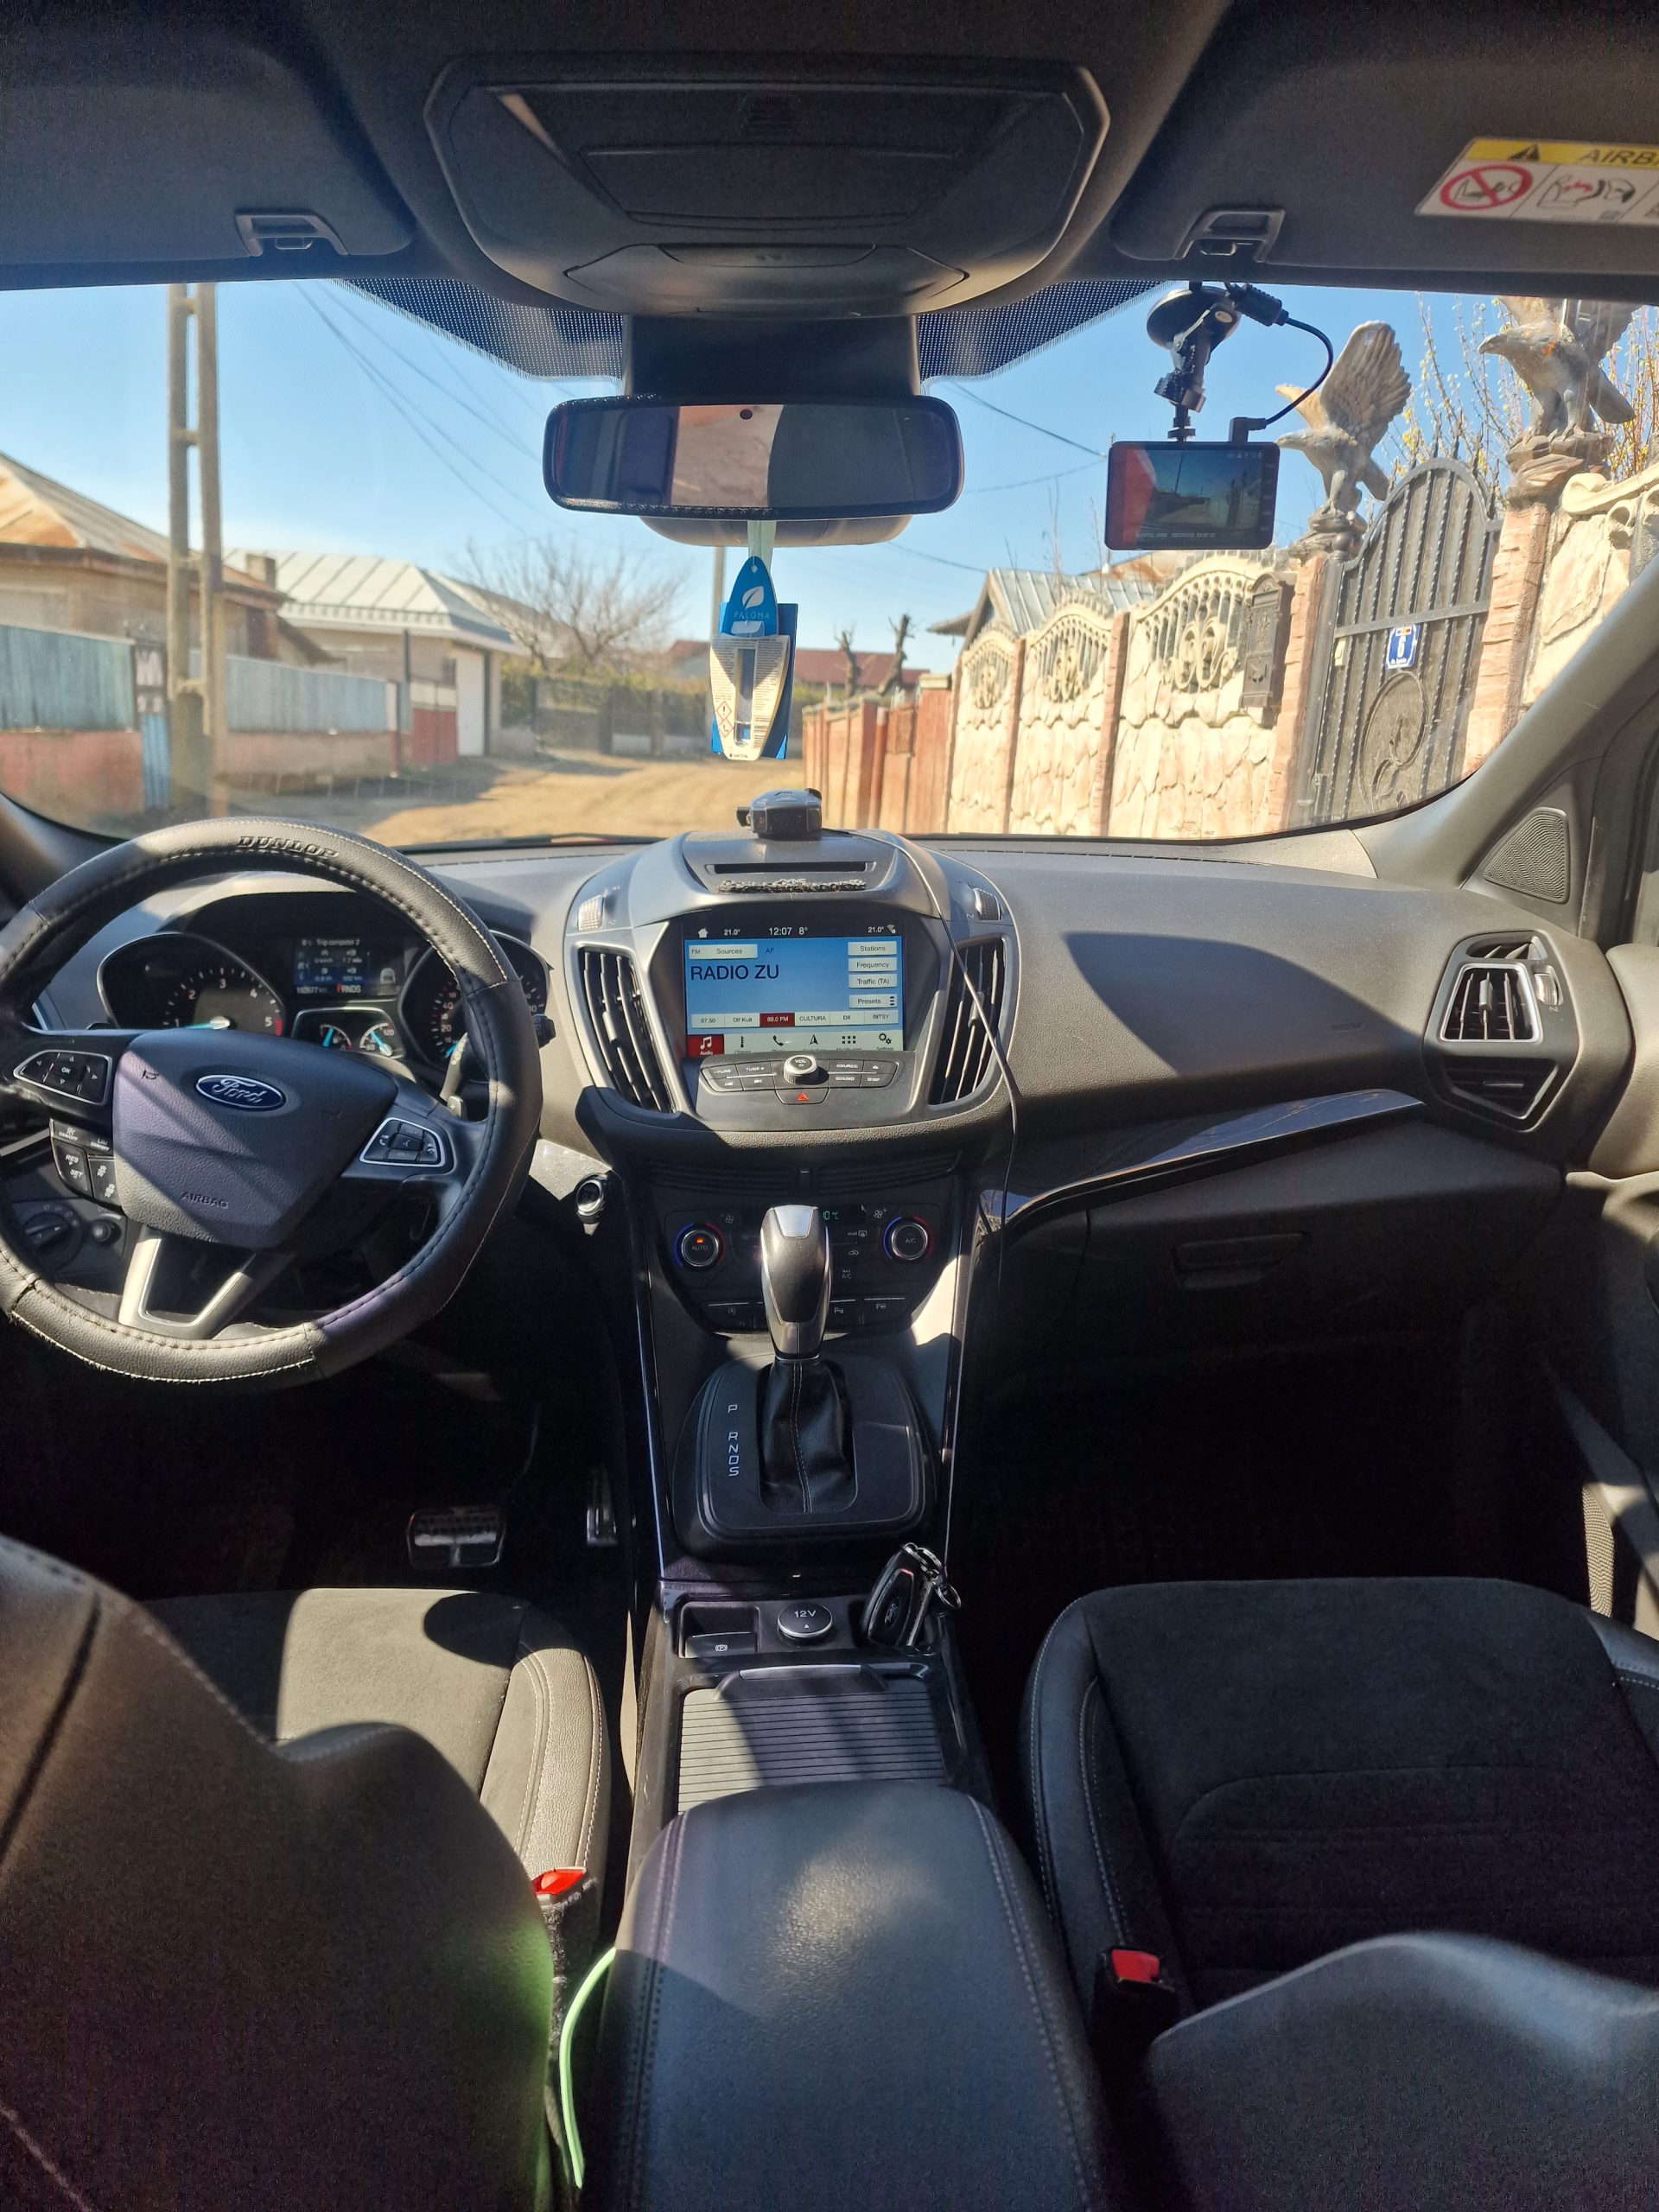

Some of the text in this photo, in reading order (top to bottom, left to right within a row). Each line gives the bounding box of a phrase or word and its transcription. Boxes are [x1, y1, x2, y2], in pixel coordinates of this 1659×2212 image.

[734, 610, 770, 620] PALOMA
[236, 836, 340, 859] DUNLOP
[768, 926, 792, 936] 12:07
[690, 964, 779, 981] RADIO ZU
[264, 1016, 273, 1027] 5
[212, 1077, 268, 1104] Ford
[181, 1192, 230, 1209] AIRBAG
[728, 1404, 738, 1414] P
[728, 1432, 739, 1441] R
[728, 1444, 739, 1453] N
[728, 1455, 739, 1465] D
[728, 1466, 739, 1477] S
[794, 1609, 817, 1618] 12V
